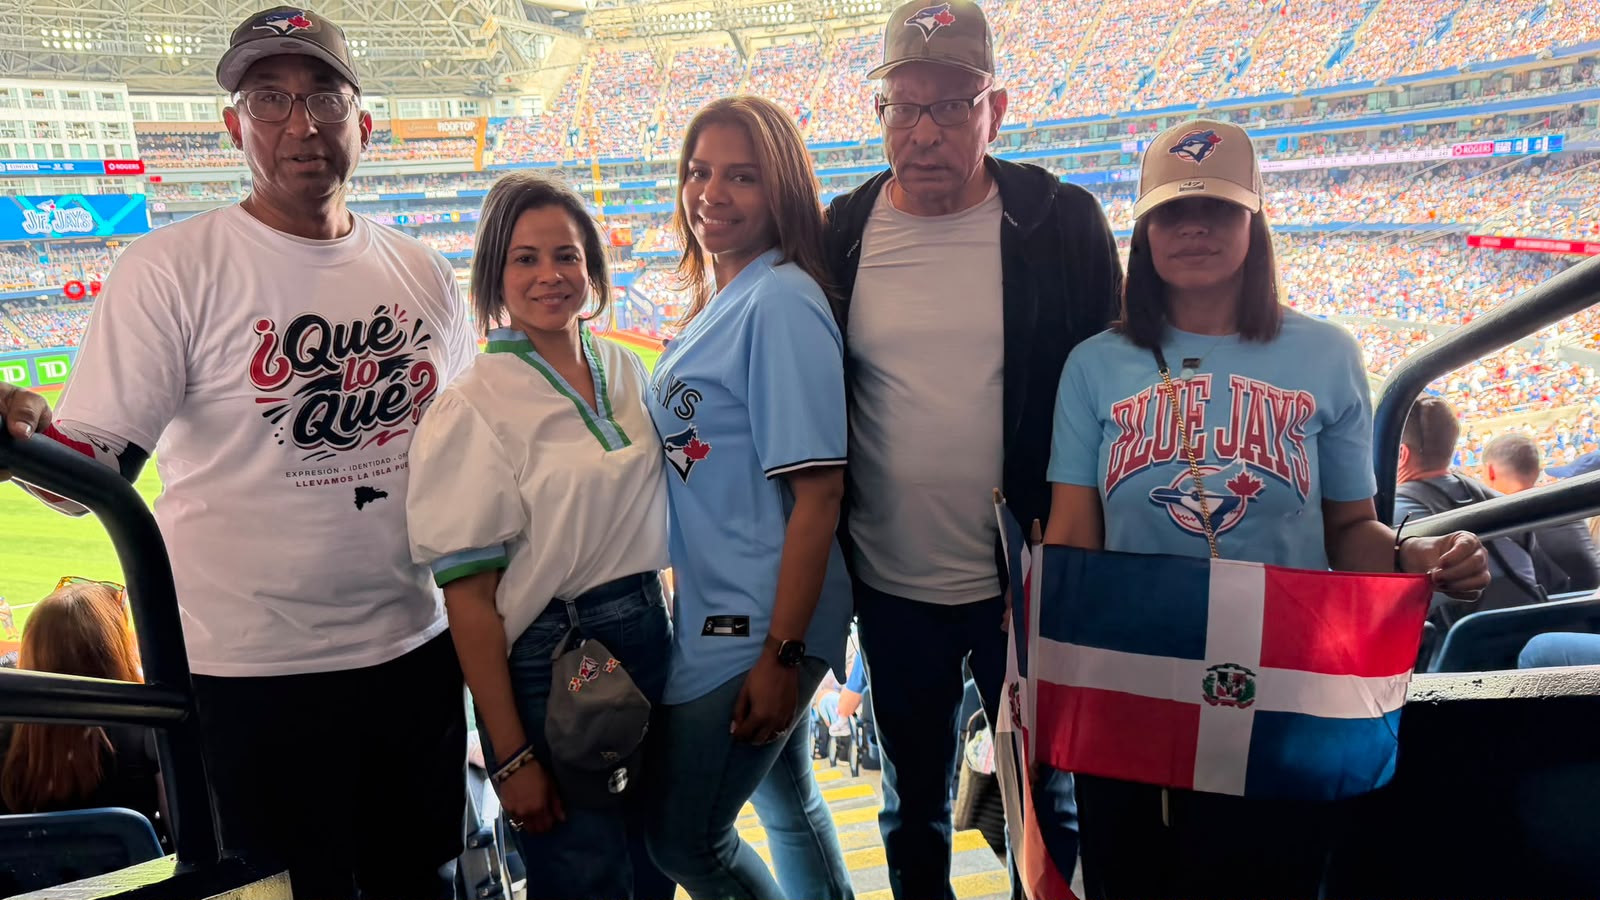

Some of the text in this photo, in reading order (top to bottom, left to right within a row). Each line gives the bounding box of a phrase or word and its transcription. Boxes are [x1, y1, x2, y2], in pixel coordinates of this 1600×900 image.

[437, 121, 476, 131] ROOFTOP
[1462, 144, 1491, 154] ROGERS
[52, 207, 93, 233] JAYS
[250, 304, 408, 392] ¿Qué
[39, 361, 67, 379] TD
[1105, 373, 1317, 503] BLUE JAYS
[349, 457, 391, 472] IDENTIDAD
[296, 475, 354, 488] LLEVAMOS
[372, 467, 391, 477] ISLA
